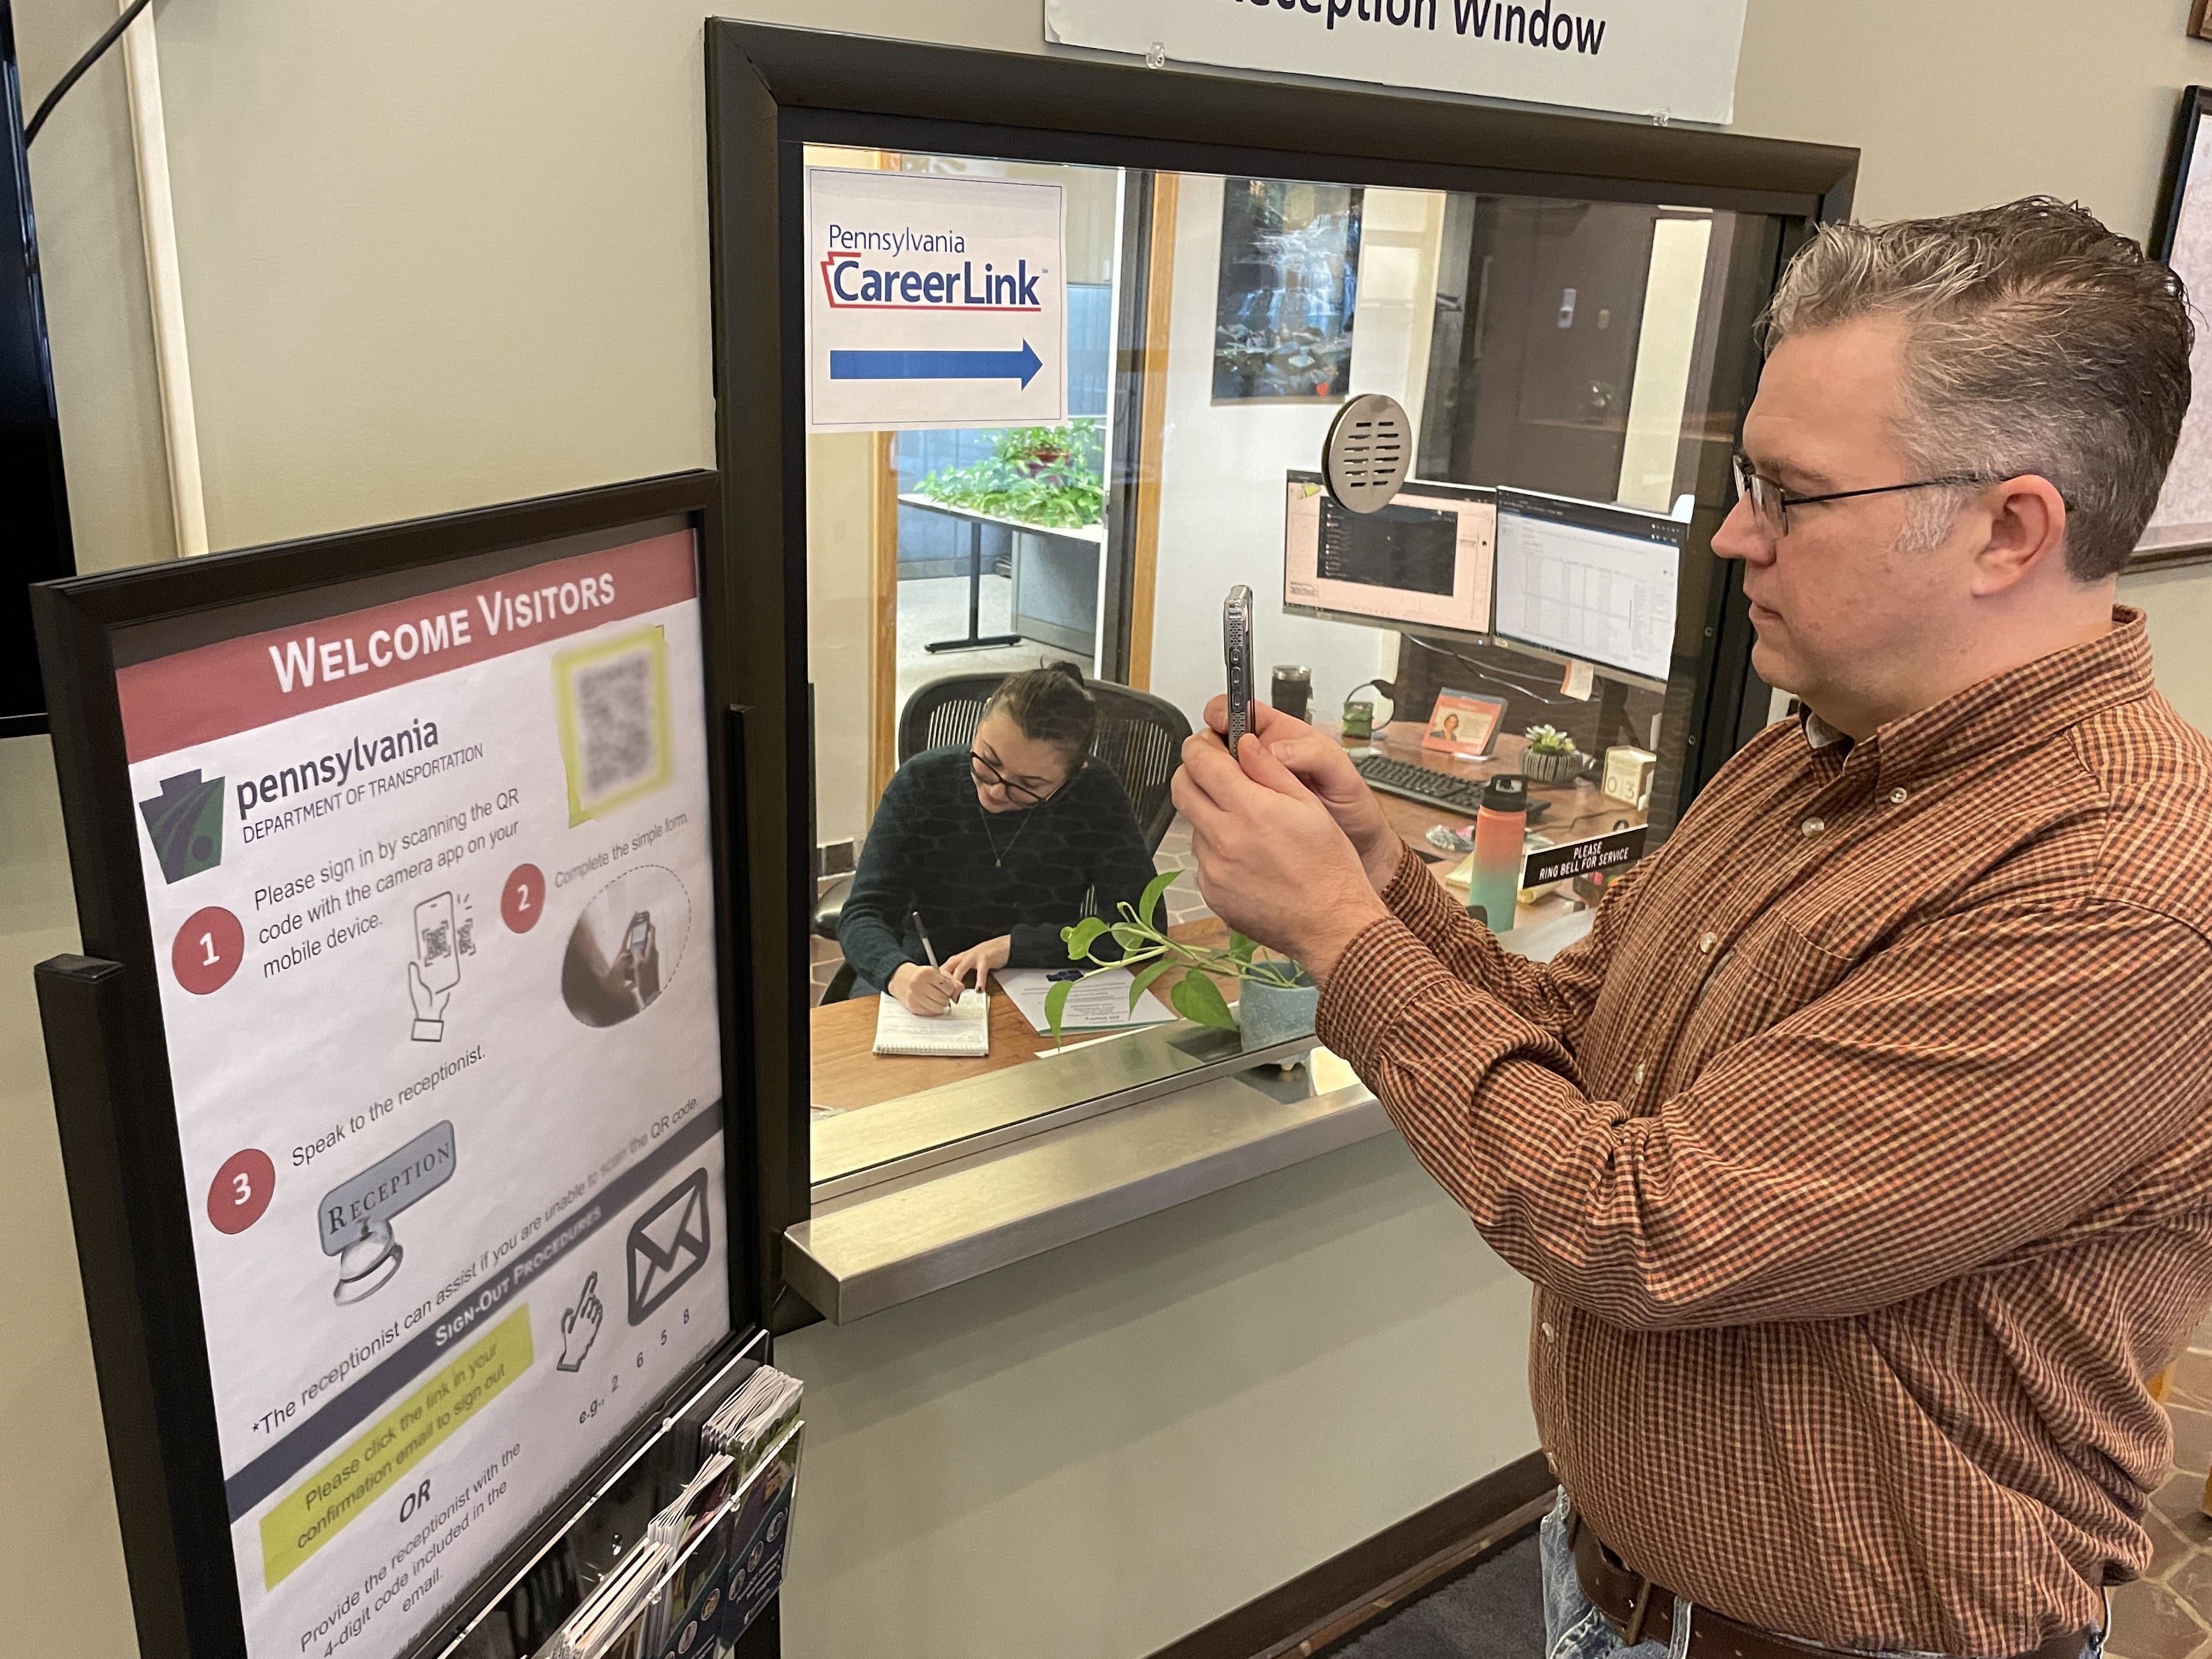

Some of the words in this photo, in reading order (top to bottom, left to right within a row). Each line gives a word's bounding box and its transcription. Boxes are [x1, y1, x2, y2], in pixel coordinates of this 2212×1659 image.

[1453, 0, 1606, 55] Window
[829, 224, 965, 257] Pennsylvania
[833, 259, 1041, 305] CareerLink
[269, 609, 472, 693] WELCOME
[476, 572, 616, 636] VISITORS
[237, 718, 439, 820] pennsylvania
[243, 792, 342, 843] DEPARTMENT
[346, 784, 366, 805] OF
[368, 743, 483, 797] TRANSPORTATION
[255, 874, 315, 911] Please
[320, 857, 354, 882] sign
[359, 848, 374, 867] in
[378, 840, 397, 860] by
[402, 812, 467, 849] scanning
[471, 802, 493, 821] the
[496, 788, 519, 810] QR
[259, 914, 303, 944] code
[308, 895, 341, 923] with
[346, 884, 371, 906] the
[376, 858, 433, 893] camera
[438, 845, 464, 868] app
[468, 836, 485, 853] on
[489, 821, 518, 849] your
[555, 852, 609, 888] Complete
[612, 842, 629, 860] the
[632, 823, 663, 851] simple
[664, 813, 689, 833] form.
[1539, 864, 1558, 881] RING
[1560, 861, 1579, 876] BELL
[1581, 856, 1596, 870] FOR
[1598, 846, 1630, 866] SERVICE
[1573, 841, 1603, 860] PLEASE
[517, 884, 530, 912] 2
[199, 932, 220, 966] 1
[264, 939, 321, 978] mobile
[327, 914, 383, 948] device.
[293, 1124, 346, 1166] Speak
[350, 1115, 365, 1133] to
[369, 1098, 394, 1122] the
[398, 1045, 485, 1105] receptionist.
[232, 1172, 252, 1206] 3
[327, 1142, 453, 1234] RECEPTION
[302, 1321, 400, 1406] receptionist
[404, 1300, 432, 1329] can
[436, 1261, 477, 1305] assist
[481, 1250, 489, 1271] if
[493, 1234, 517, 1266] you
[521, 1216, 542, 1240] are
[545, 1182, 585, 1221] unable
[651, 1115, 669, 1138] QR
[435, 1276, 511, 1347] SIGN-OUT
[513, 1205, 601, 1285] PROCEDURES
[611, 1374, 618, 1393] 2
[637, 1351, 643, 1368] 6
[661, 1329, 667, 1345] 5
[683, 1308, 690, 1324] 8
[298, 1462, 392, 1548] confirmation
[437, 1412, 451, 1430] to
[454, 1385, 481, 1415] sign
[485, 1363, 505, 1389] out
[305, 1458, 360, 1511] Please
[364, 1426, 397, 1461] click
[400, 1406, 423, 1431] the
[426, 1381, 451, 1410] link
[454, 1370, 466, 1388] in
[469, 1341, 498, 1380] your
[400, 1478, 431, 1523] OR
[301, 1591, 360, 1652] Provide
[364, 1565, 387, 1594] the
[392, 1488, 470, 1569] receptionist
[473, 1463, 499, 1493] with
[502, 1442, 521, 1467] the
[324, 1607, 371, 1658] 4-digit
[375, 1572, 409, 1612] code
[413, 1512, 469, 1576] included
[472, 1502, 485, 1520] in
[488, 1481, 508, 1506] the
[403, 1566, 443, 1612] email.
